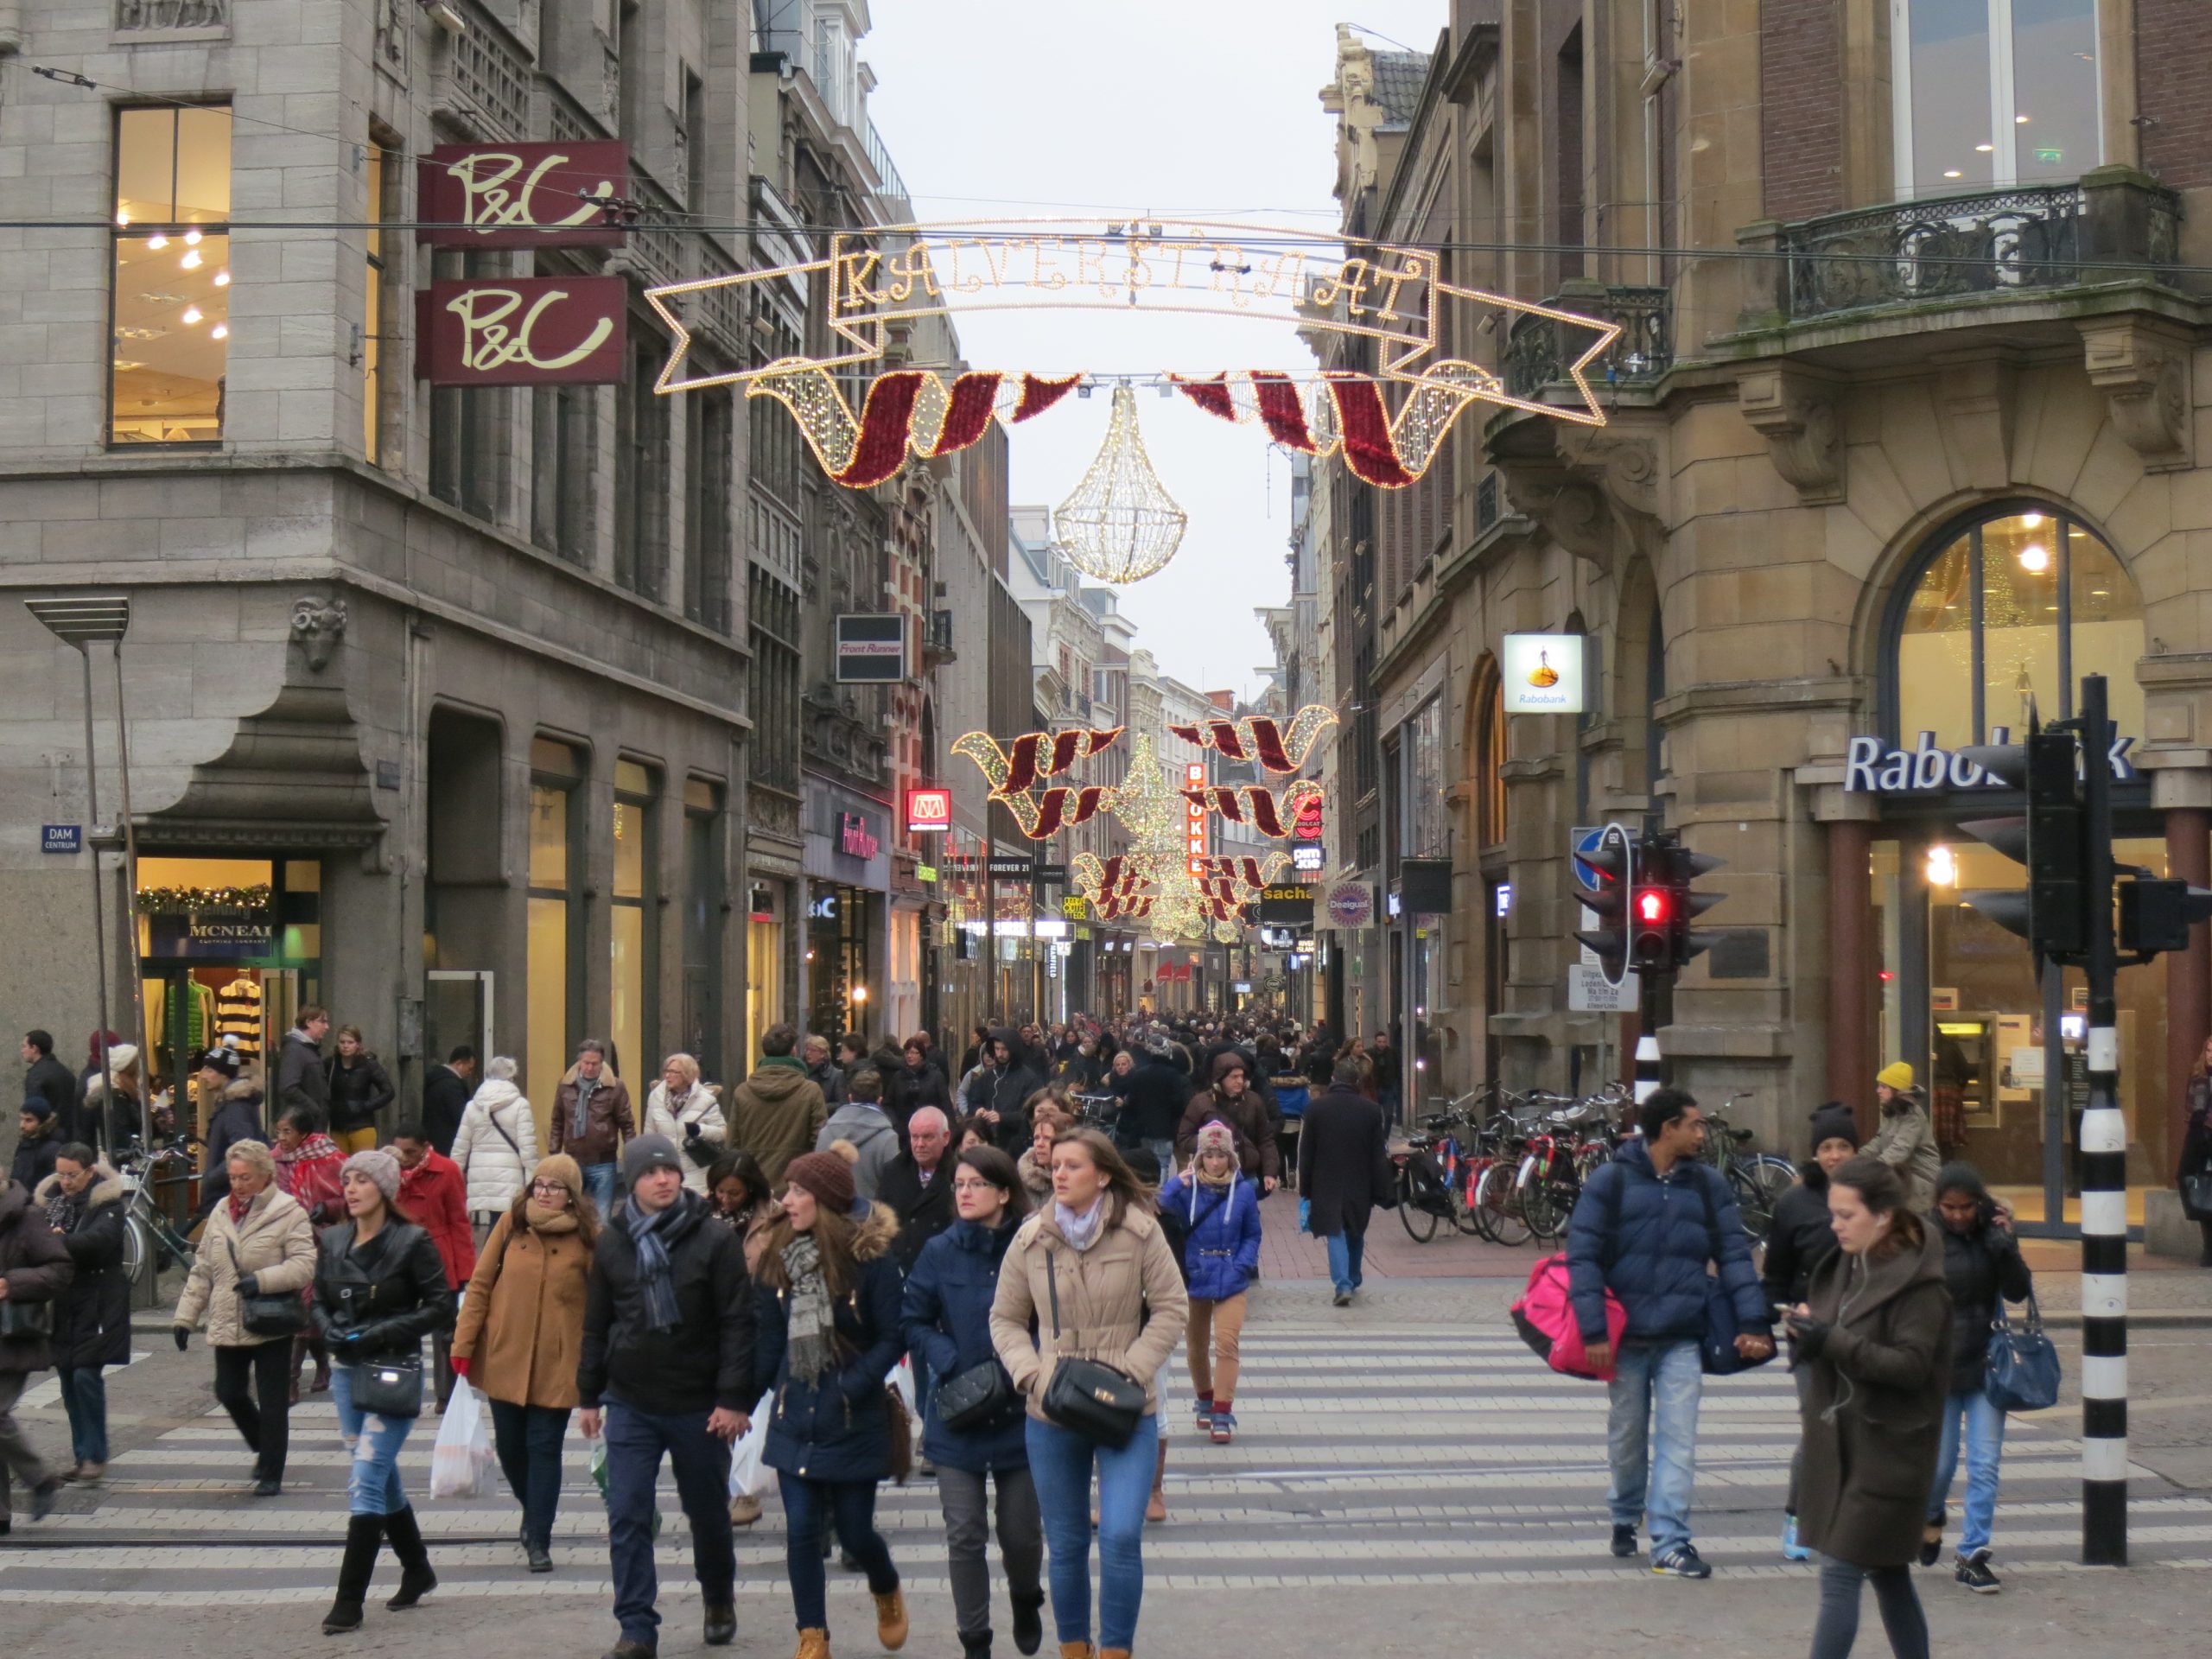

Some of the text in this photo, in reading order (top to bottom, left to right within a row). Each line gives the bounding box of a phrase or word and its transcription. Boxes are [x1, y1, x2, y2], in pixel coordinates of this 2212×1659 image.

[447, 154, 613, 234] P&C
[838, 227, 1422, 320] KALVERSTRAAT
[446, 289, 613, 371] P&C
[839, 643, 900, 652] Front Runner
[1519, 694, 1567, 703] Rabobank
[1844, 727, 2135, 791] Rabok
[49, 828, 73, 839] DAM
[1329, 899, 1368, 910] Desigual
